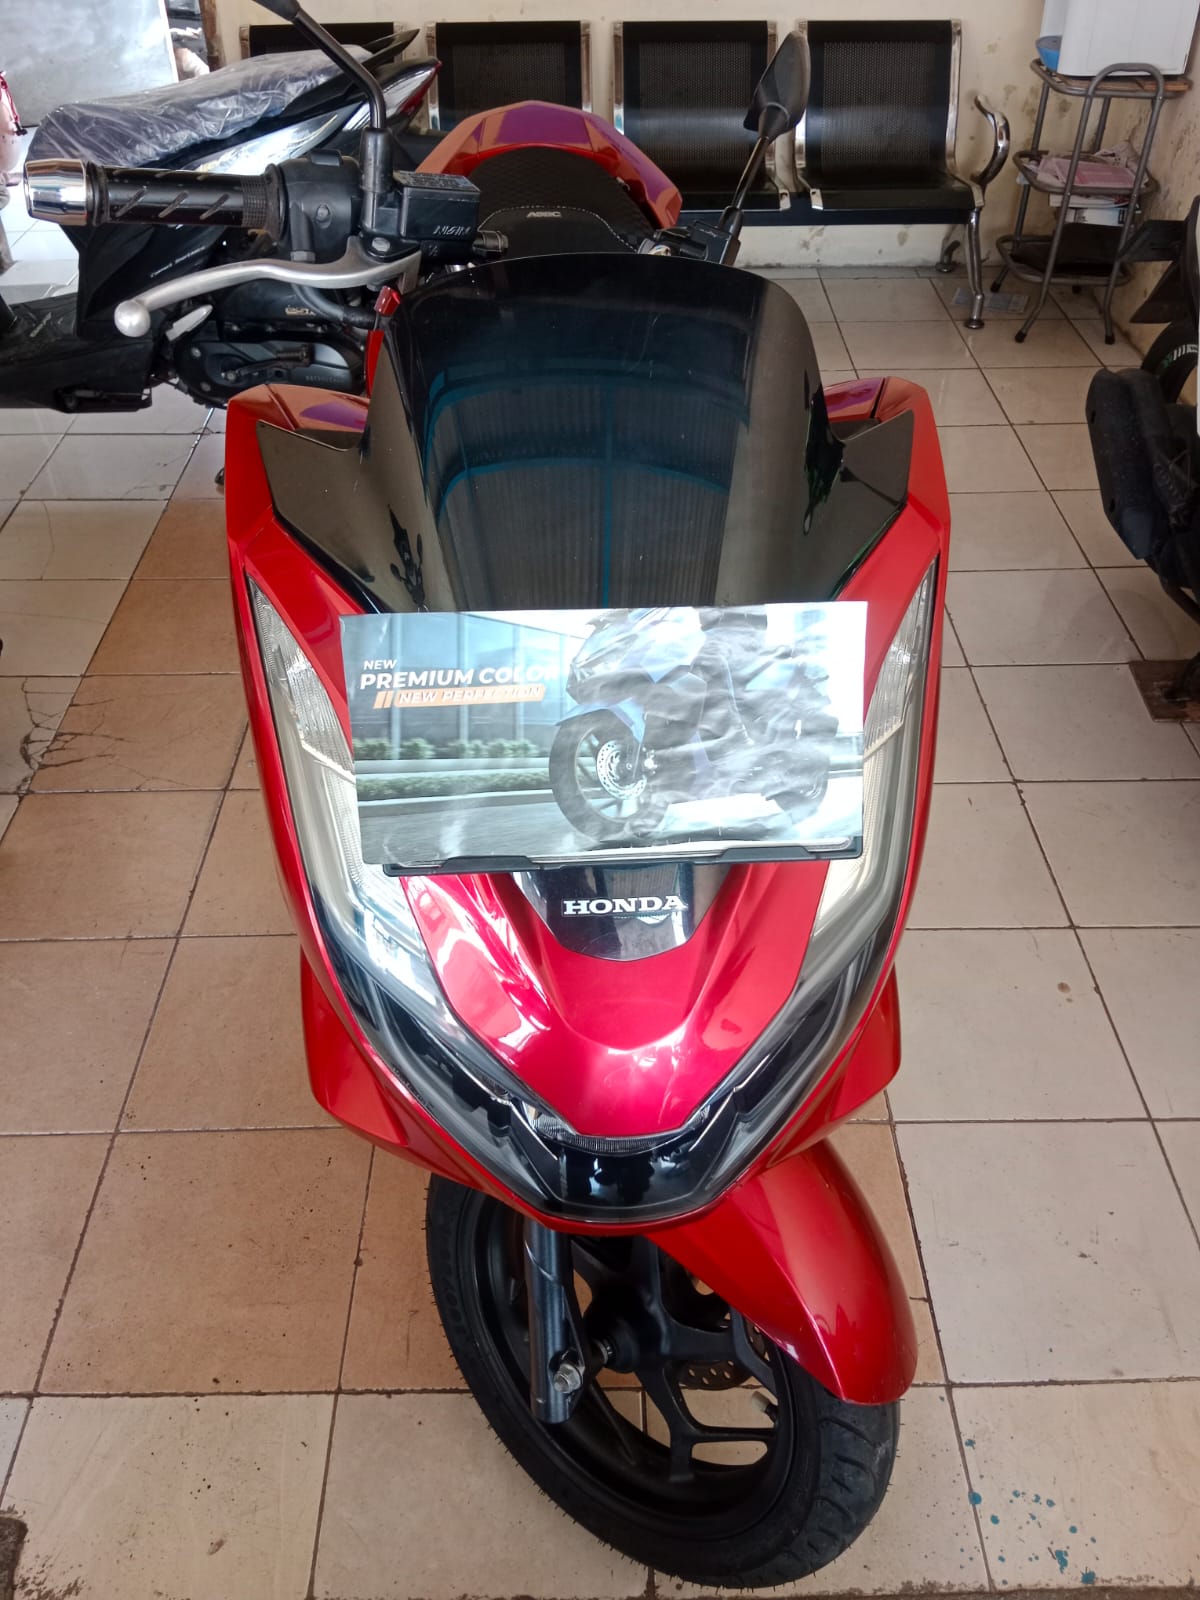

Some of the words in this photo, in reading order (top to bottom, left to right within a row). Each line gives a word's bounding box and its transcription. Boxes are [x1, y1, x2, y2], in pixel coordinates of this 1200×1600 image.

[363, 660, 398, 670] NEW
[360, 668, 474, 689] PREMIUM
[399, 690, 438, 705] NEW
[563, 895, 688, 915] HONDA
